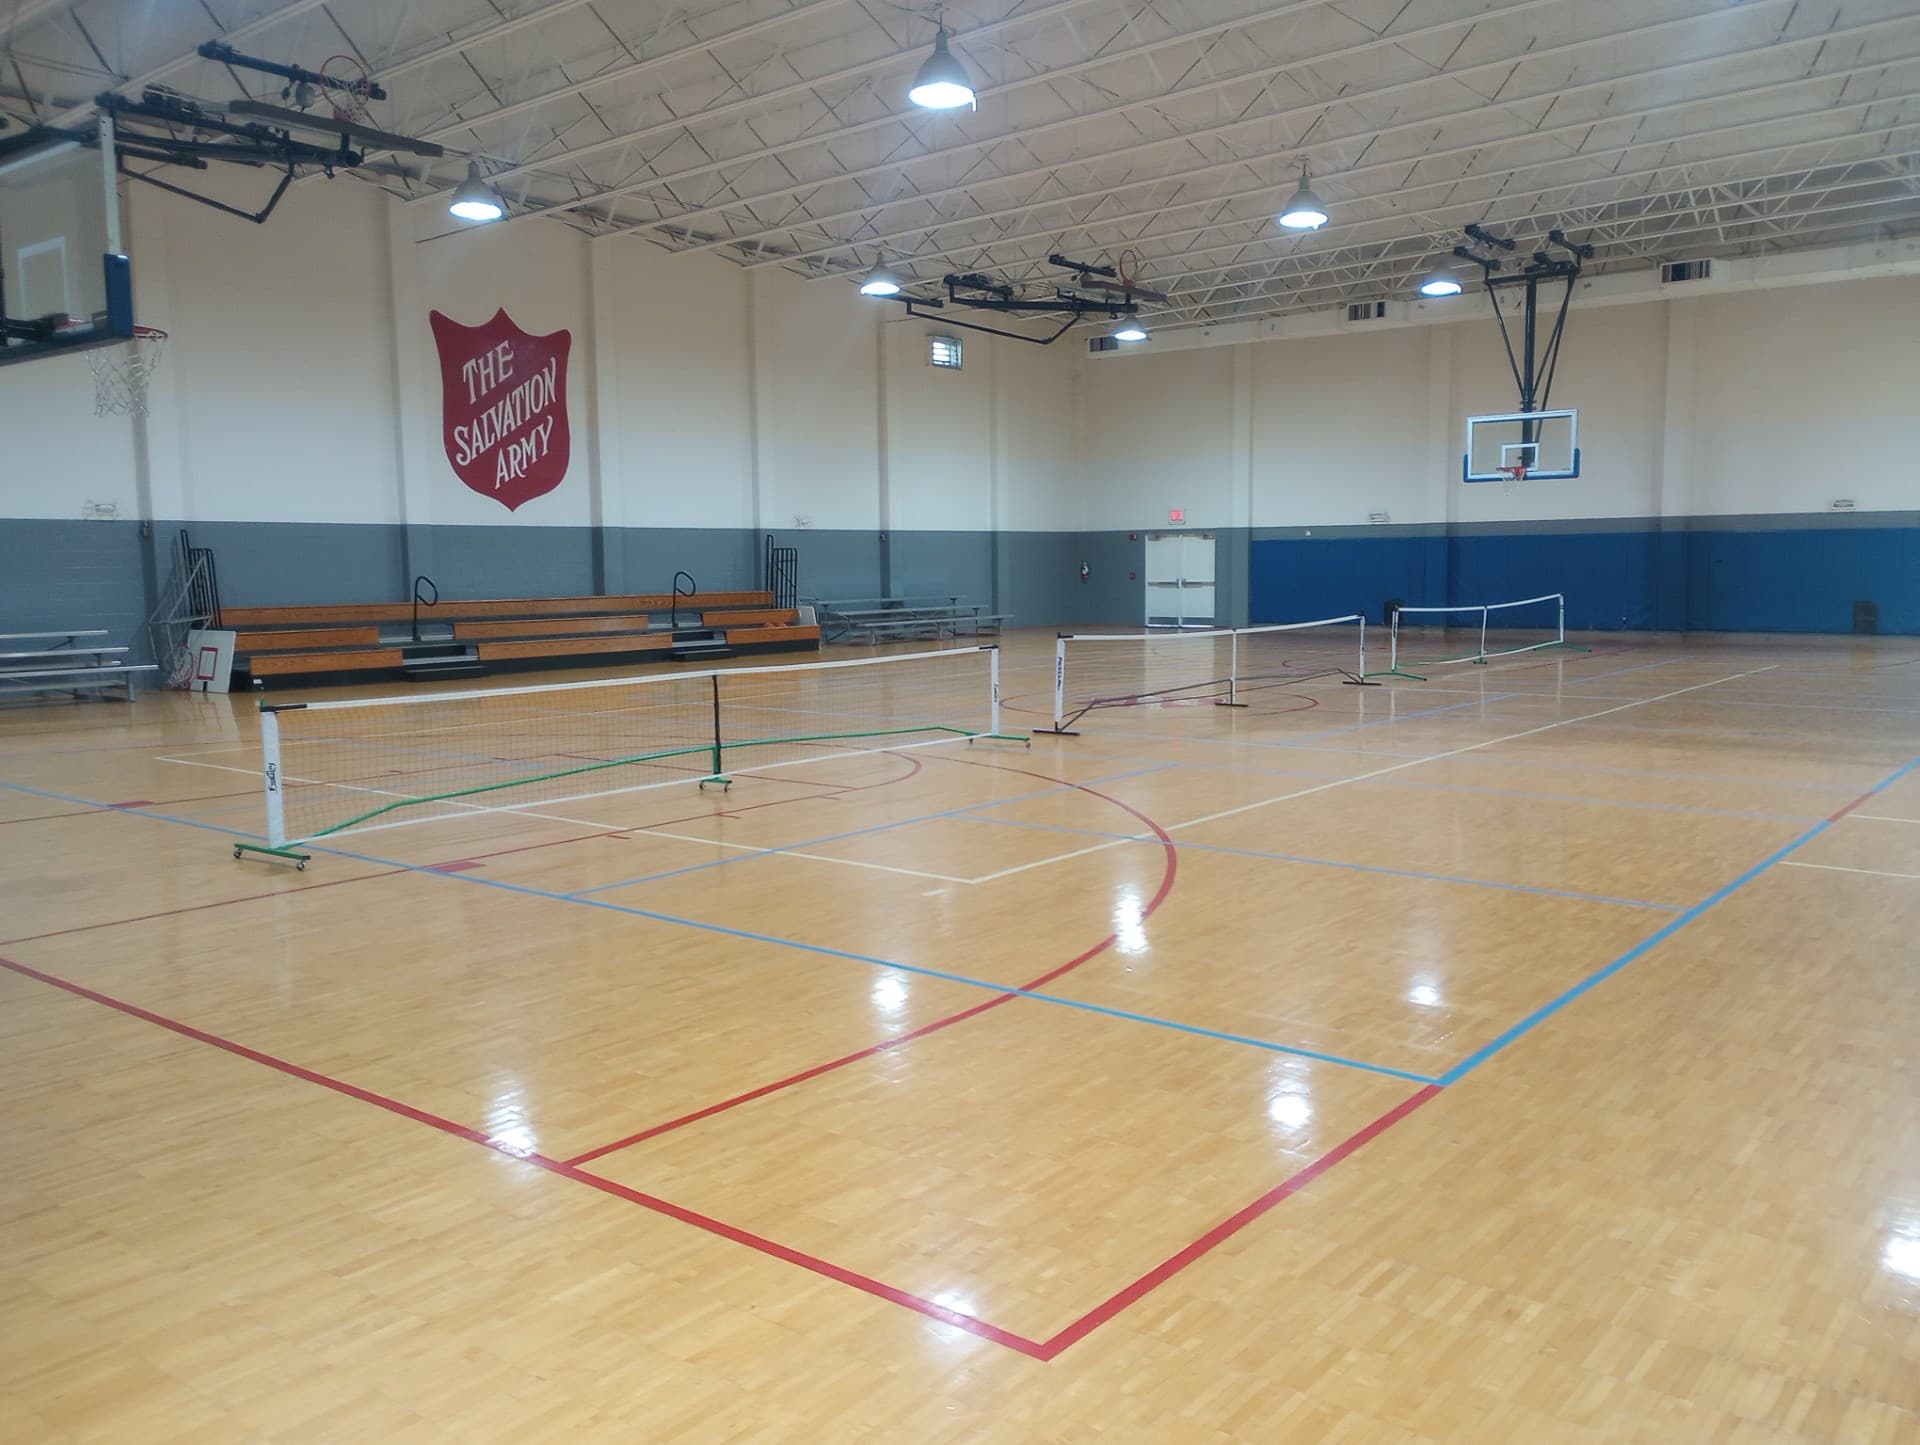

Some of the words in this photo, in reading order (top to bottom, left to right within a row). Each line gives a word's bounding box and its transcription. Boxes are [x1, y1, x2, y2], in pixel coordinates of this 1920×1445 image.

[463, 340, 514, 405] THE
[454, 357, 556, 466] SALVATION
[495, 416, 553, 490] ARMY
